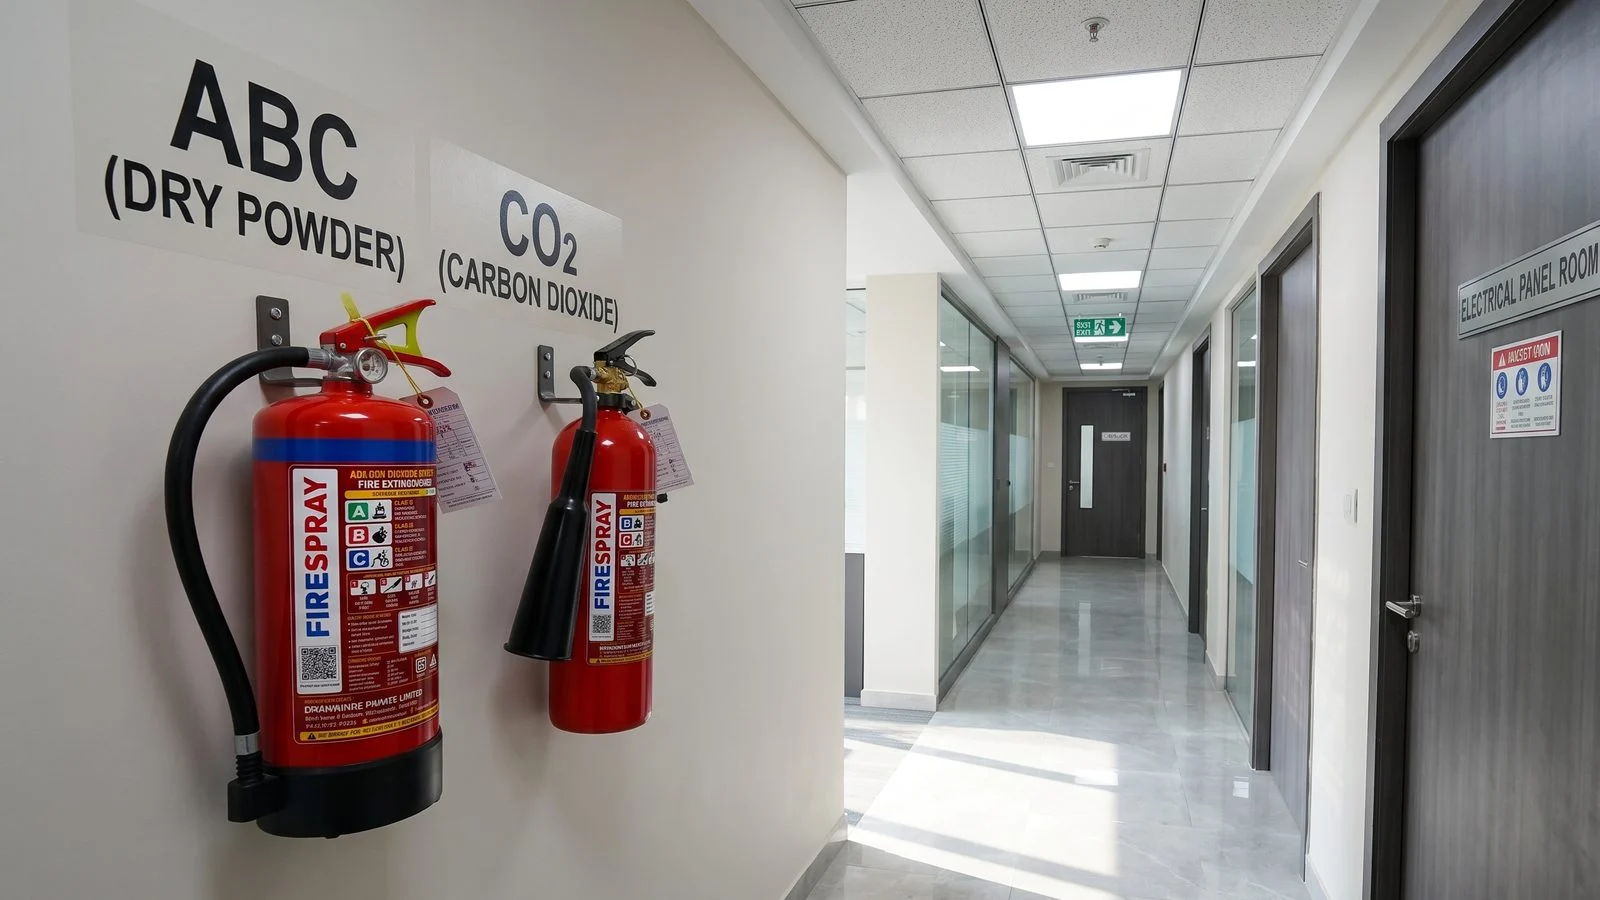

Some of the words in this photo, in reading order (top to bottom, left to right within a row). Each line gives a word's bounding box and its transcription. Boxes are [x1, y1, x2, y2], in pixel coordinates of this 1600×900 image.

[170, 58, 358, 201] ABC
[104, 154, 223, 229] (DRY
[237, 191, 406, 284] POWDER)
[438, 248, 542, 308] (CARBON
[547, 280, 619, 334] DIOXIDE)
[1460, 282, 1517, 323] ELECTRICAL
[1519, 261, 1556, 302] PANEL
[1558, 242, 1599, 286] ROOM
[358, 479, 380, 489] FIRE
[352, 505, 366, 518] A
[352, 528, 366, 542] B
[623, 519, 631, 529] B
[303, 475, 330, 639] FIRESPRAY
[353, 552, 366, 566] C
[594, 499, 613, 610] FIRESPRAY
[622, 535, 631, 545] C
